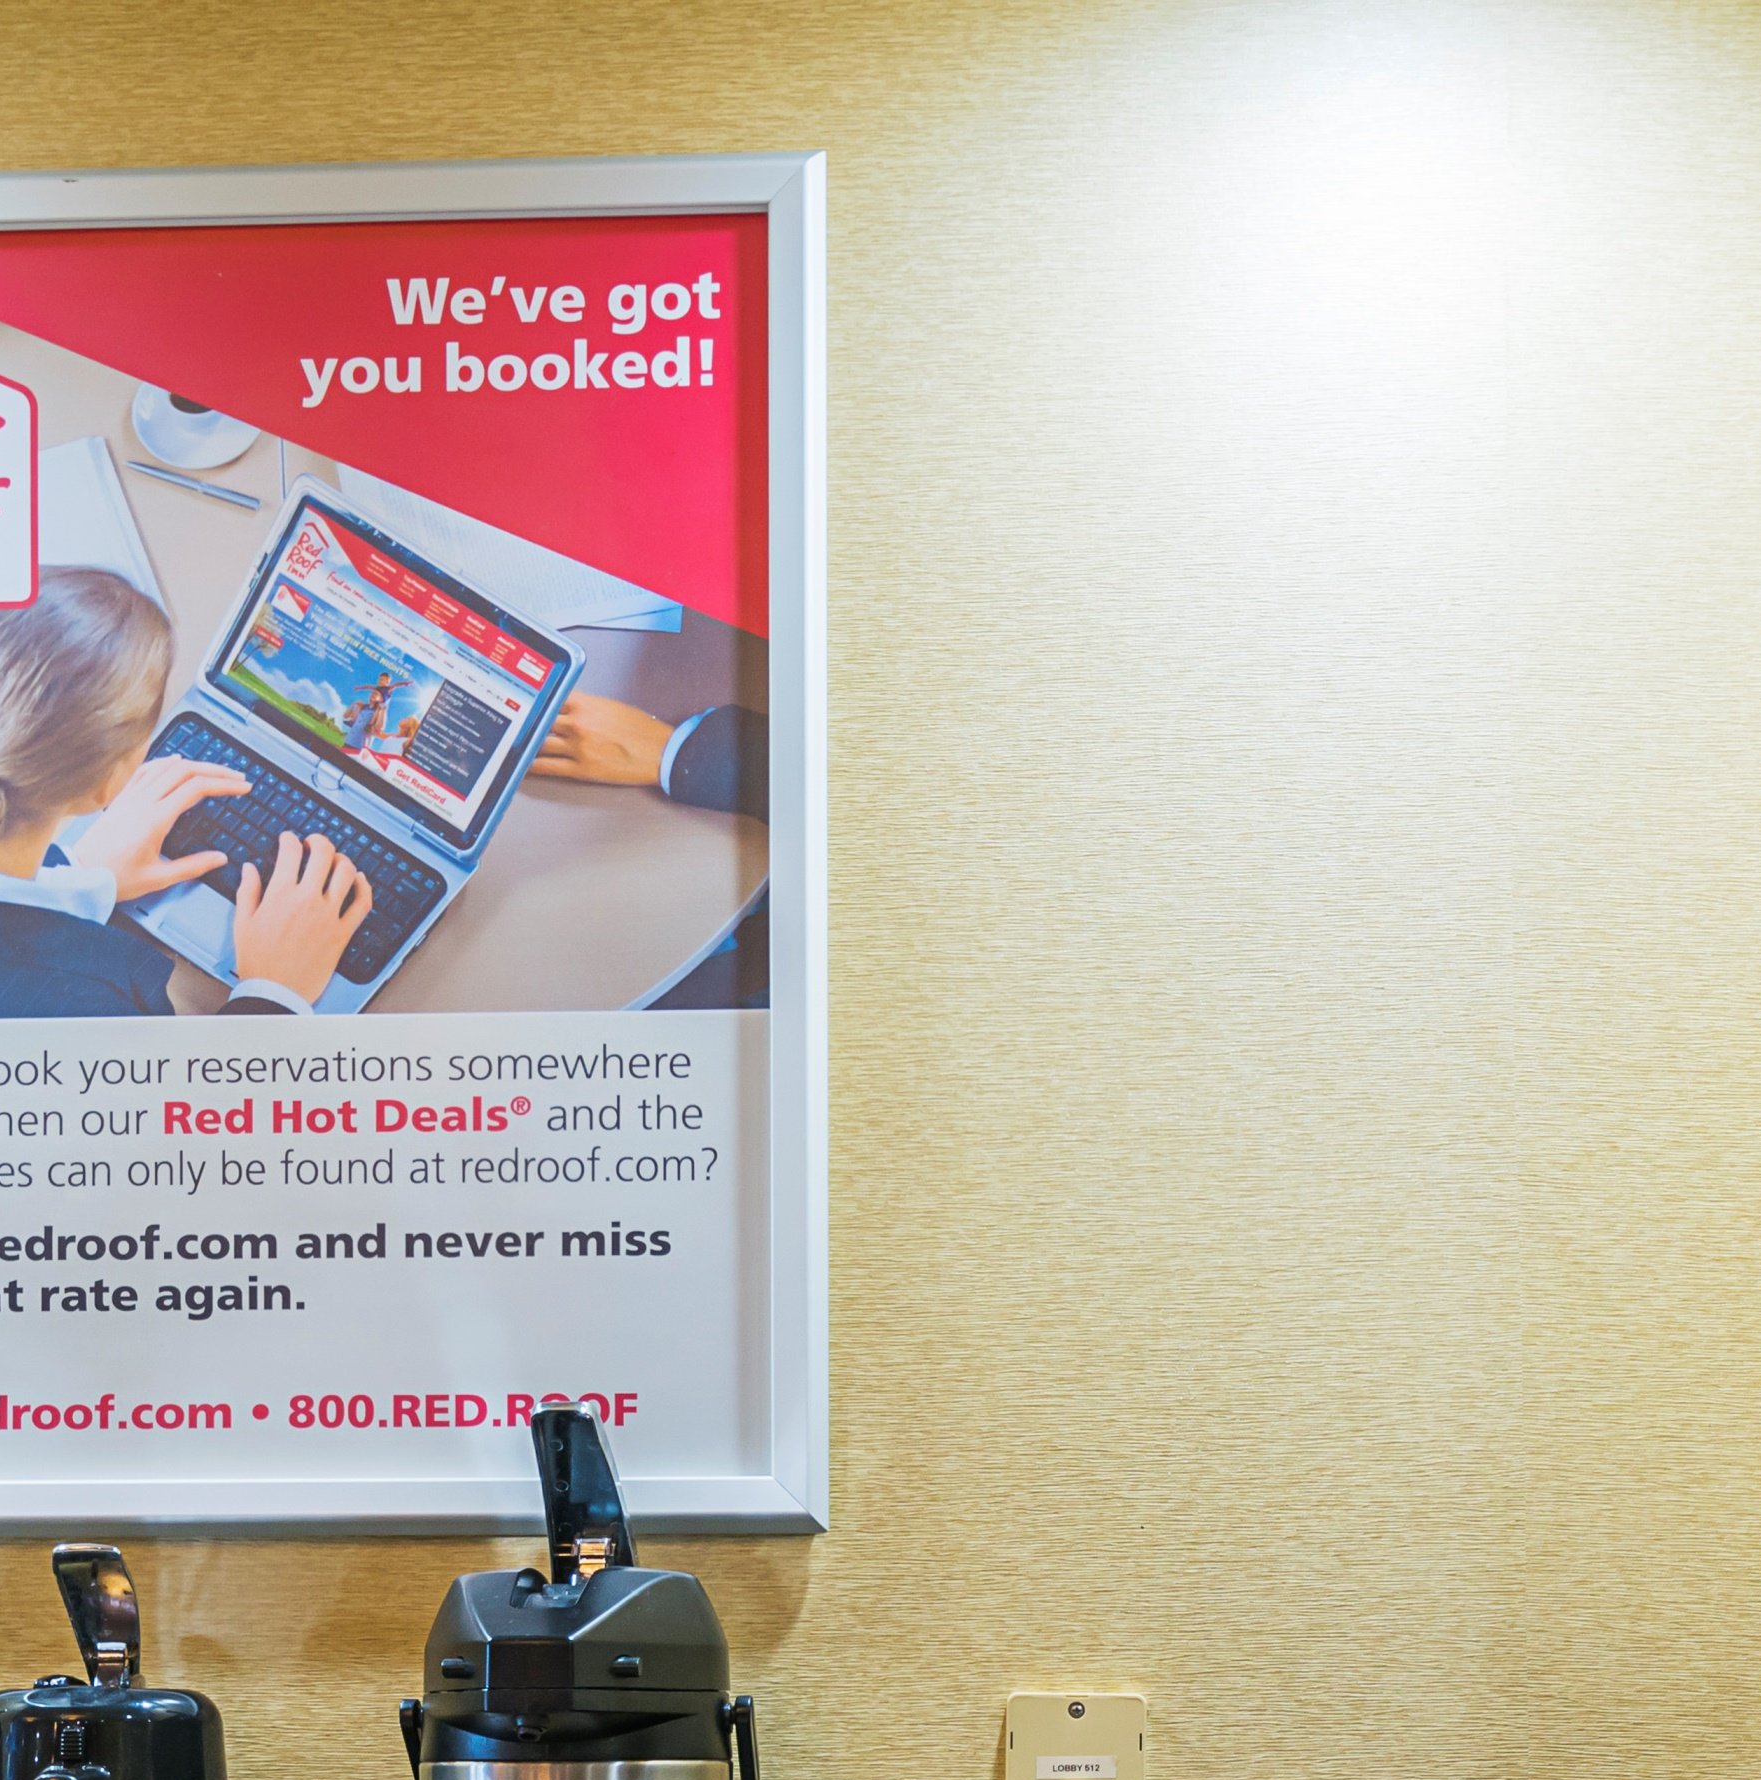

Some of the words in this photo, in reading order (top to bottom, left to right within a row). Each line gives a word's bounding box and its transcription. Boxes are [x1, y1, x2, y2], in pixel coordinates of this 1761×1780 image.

[386, 275, 586, 325] We've
[607, 271, 721, 340] got
[300, 356, 422, 409] you
[445, 335, 714, 393] booked!
[296, 530, 324, 558] Red
[395, 767, 411, 782] Get
[78, 1058, 171, 1095] your
[187, 1050, 433, 1086] reservations
[448, 1046, 691, 1083] somewhere
[79, 1107, 149, 1136] our
[164, 1099, 254, 1135] Red
[272, 1100, 358, 1134] Hot
[547, 1095, 621, 1132] and
[637, 1095, 703, 1131] the
[47, 1161, 111, 1188] can
[127, 1149, 207, 1196] only
[221, 1149, 266, 1186] be
[280, 1148, 393, 1185] found
[409, 1152, 446, 1184] at
[461, 1146, 718, 1184] redroof.com?
[295, 1222, 386, 1260] and
[404, 1231, 545, 1258] never
[561, 1220, 672, 1257] miss
[40, 1279, 139, 1313] rate
[155, 1276, 305, 1321] again.
[1051, 1764, 1083, 1773] LOBBY
[1084, 1763, 1101, 1772] 512
